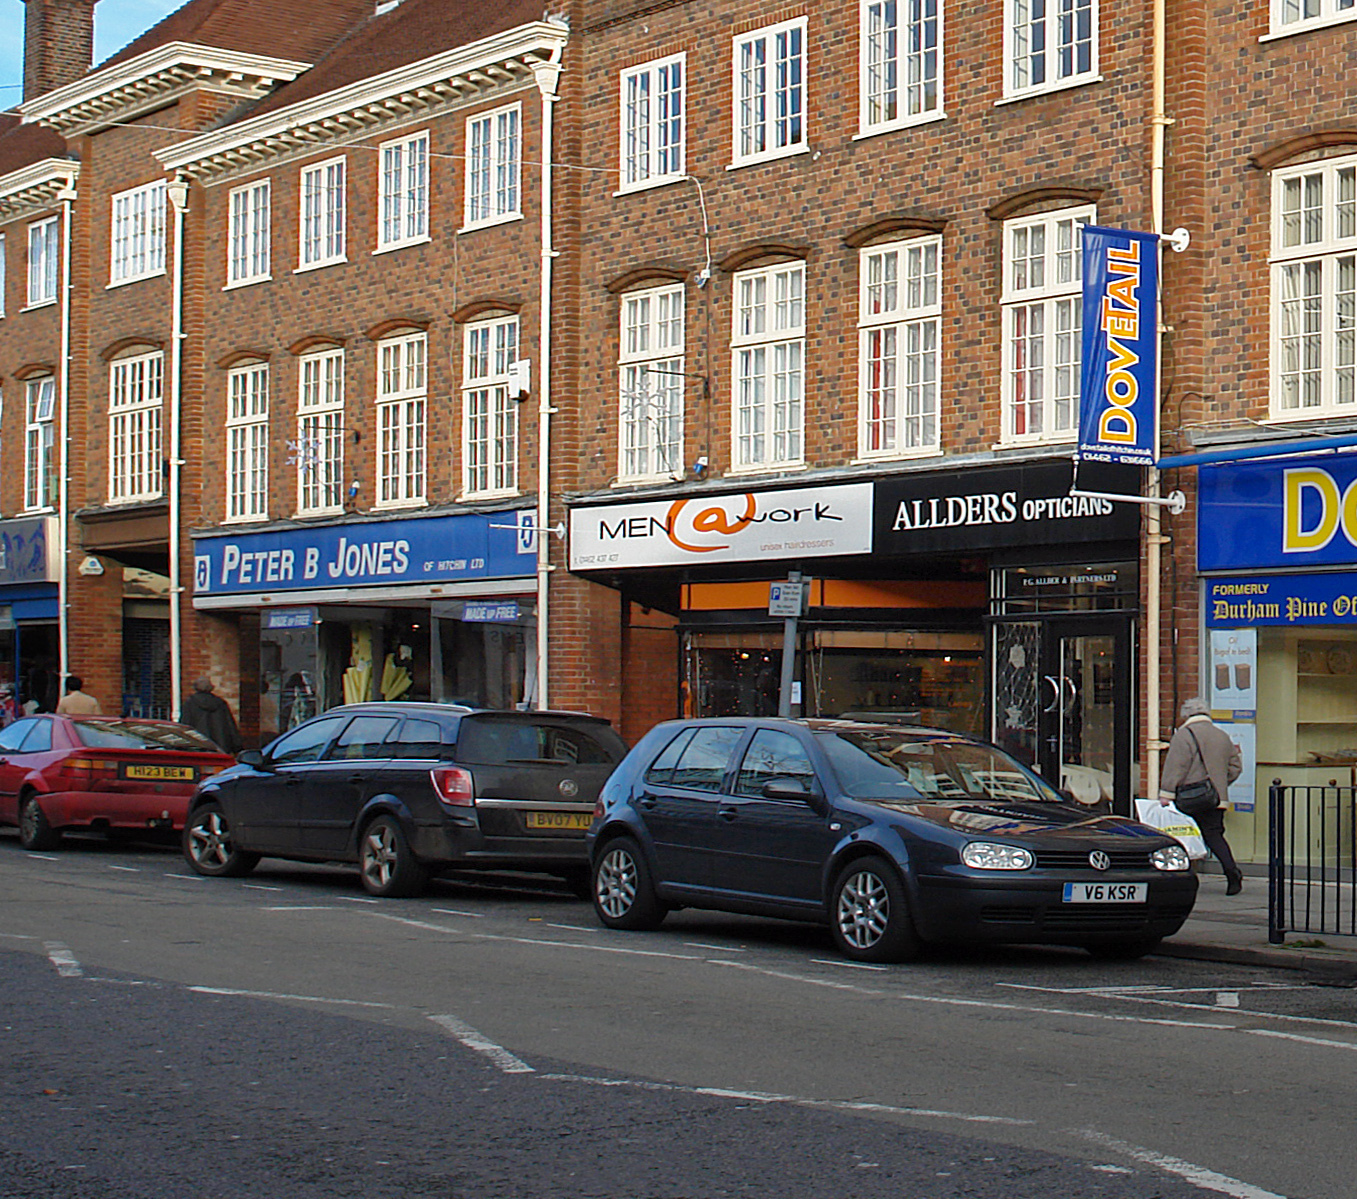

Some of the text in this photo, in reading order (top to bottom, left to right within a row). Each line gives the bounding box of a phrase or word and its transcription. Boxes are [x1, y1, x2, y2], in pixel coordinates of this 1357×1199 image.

[1098, 239, 1140, 445] DOVETAIL
[892, 491, 1113, 531] ALLDERS OPTICIANS
[220, 537, 410, 585] PETER B JONES
[423, 561, 434, 572] OF
[470, 558, 485, 569] LTD
[1212, 583, 1270, 596] FORMERLY
[465, 607, 486, 620] MADE
[495, 606, 516, 618] FREE
[1212, 599, 1280, 622] Durham
[1285, 597, 1328, 621] Pine
[1332, 595, 1357, 617] Of
[133, 766, 161, 777] H123
[537, 813, 571, 826] BV07
[1085, 885, 1137, 900] V6 KSR
